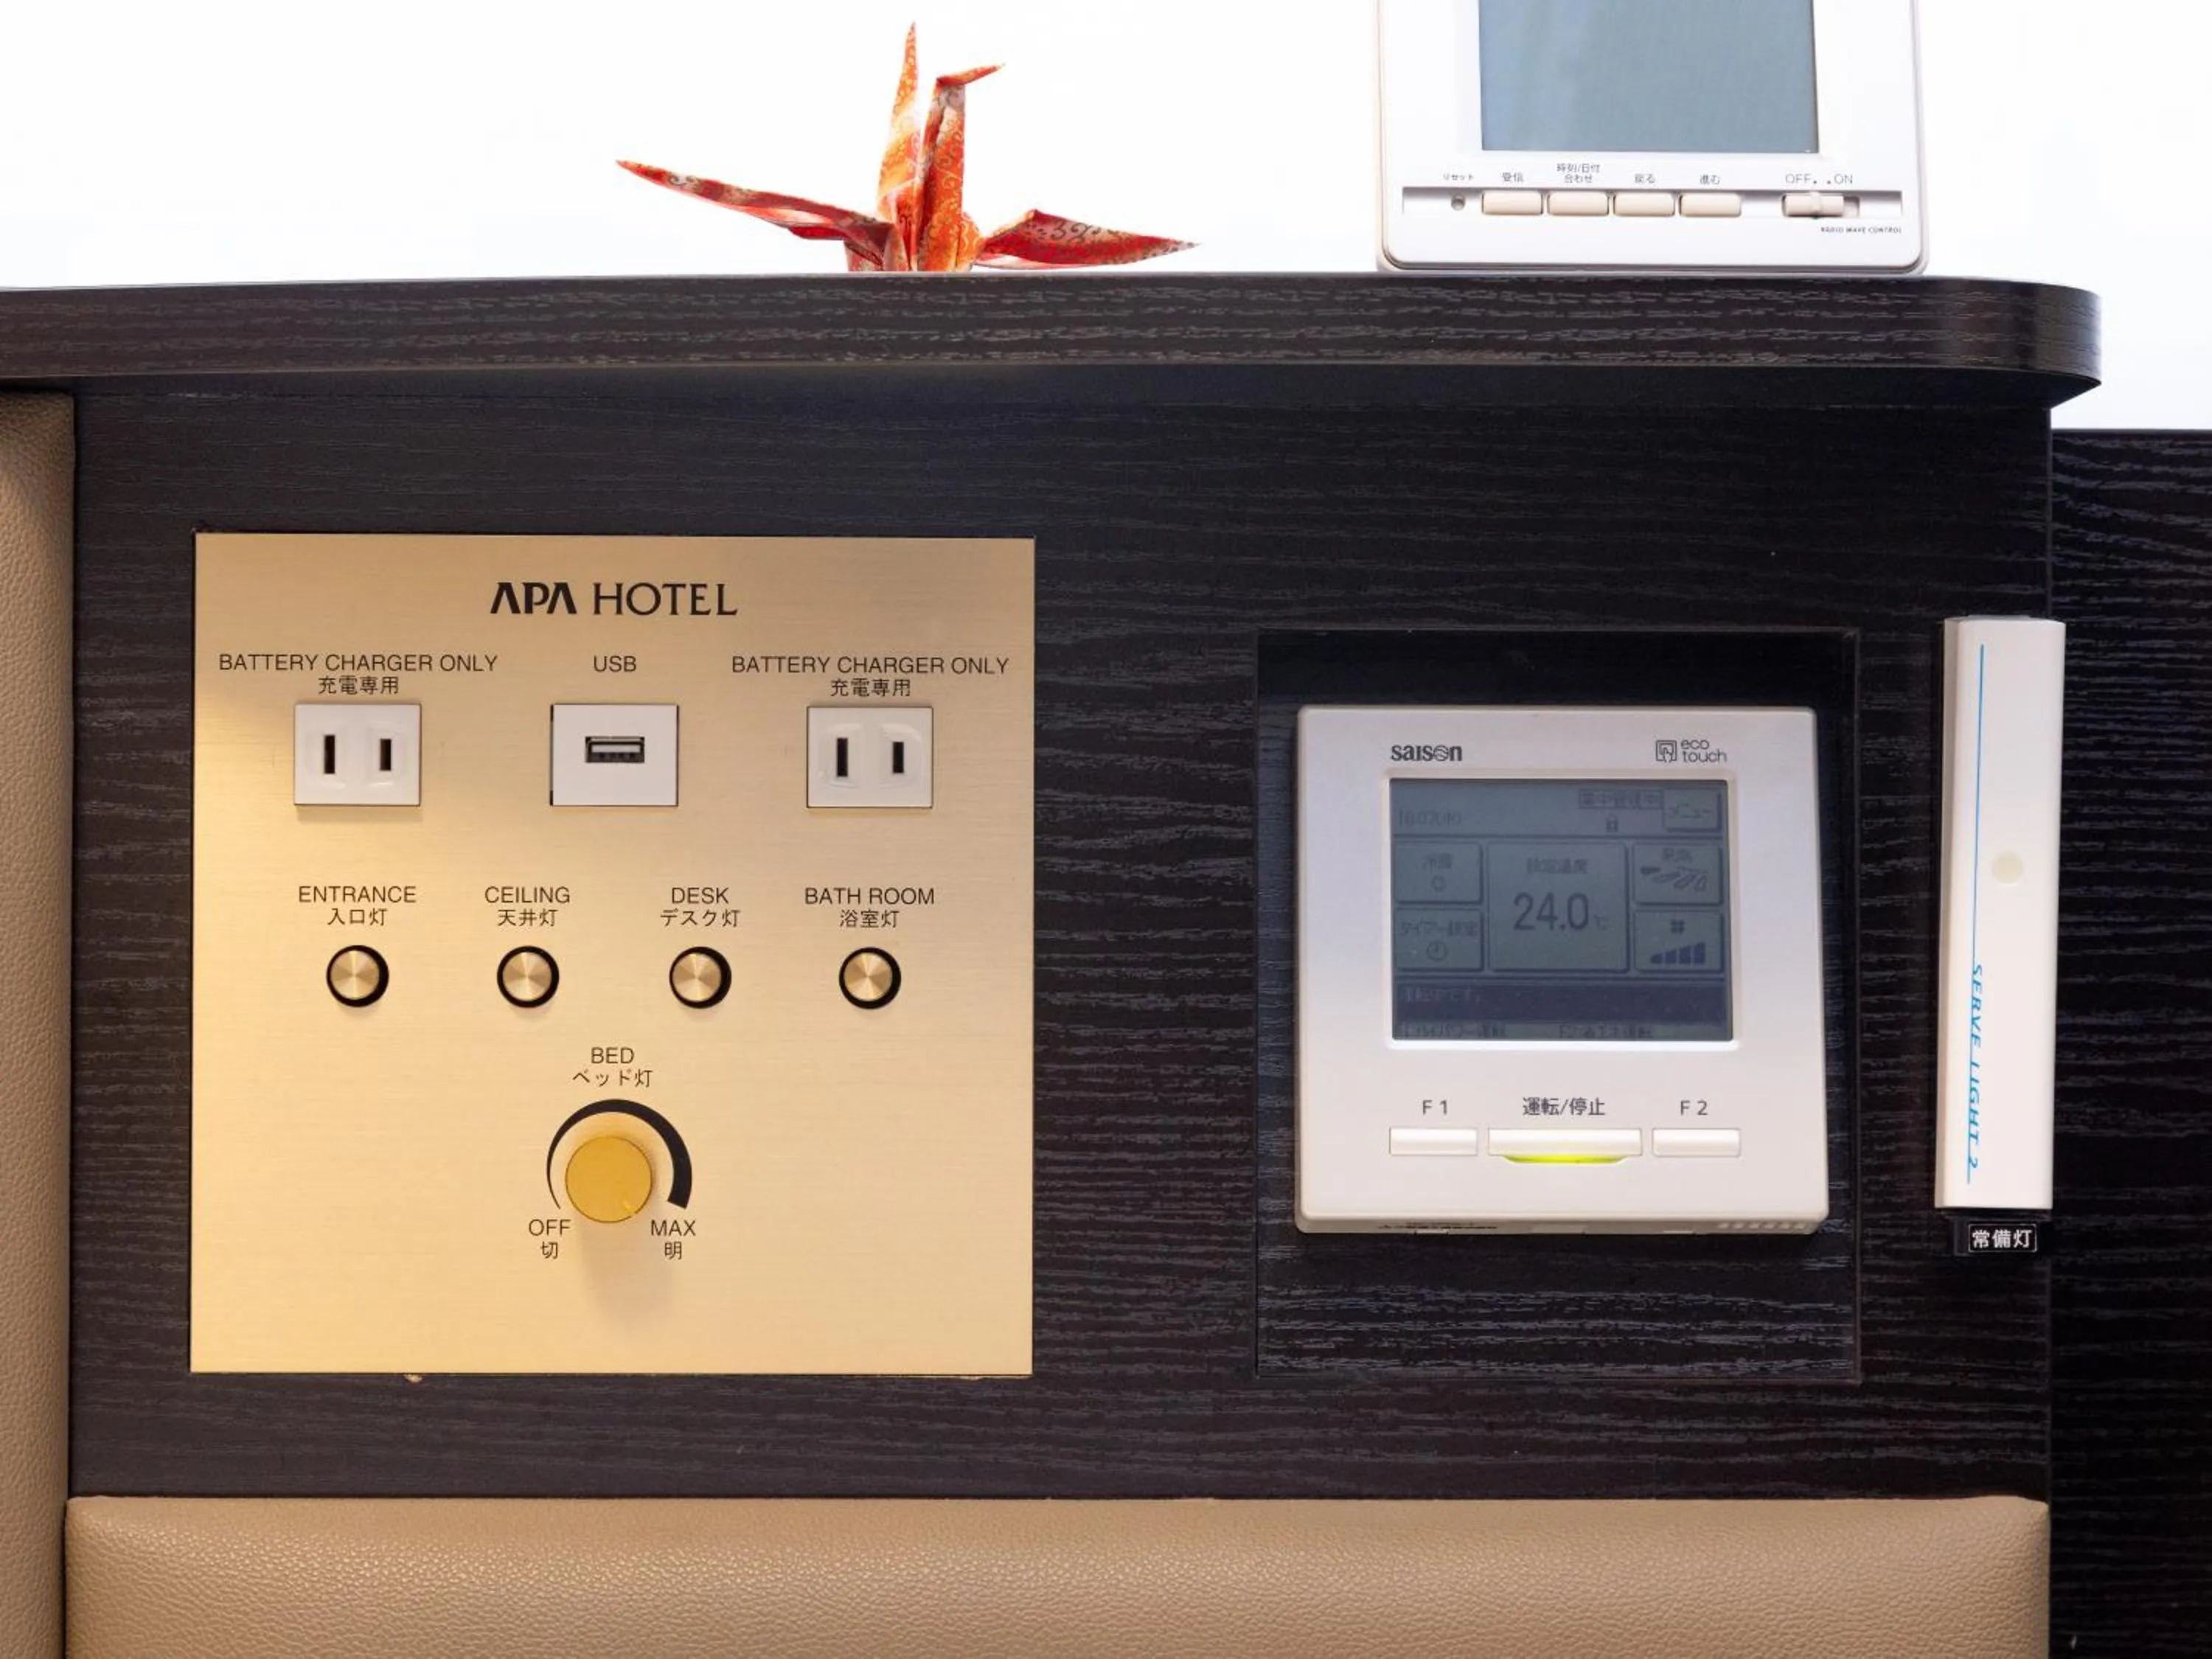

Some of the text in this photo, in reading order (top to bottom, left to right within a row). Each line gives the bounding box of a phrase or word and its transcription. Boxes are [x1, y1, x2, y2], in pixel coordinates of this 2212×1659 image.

[1501, 172, 1524, 183] 受信
[1634, 173, 1655, 184] 戻る
[1700, 174, 1720, 185] 進む
[490, 582, 737, 615] APA HOTEL
[220, 654, 497, 672] BATTERY CHARGER ONLY
[594, 655, 636, 672] USB
[733, 656, 1009, 674] BATTERY CHARGER ONLY
[319, 675, 398, 695] 充電専用
[831, 678, 910, 697] 充電専用
[1681, 740, 1709, 751] eco
[1681, 747, 1727, 762] touch
[299, 886, 416, 902] ENTRANCE
[485, 886, 570, 903] CEILING
[672, 887, 728, 904] DESK
[805, 888, 933, 905] BATH ROOM
[327, 908, 386, 926] 入口灯
[498, 908, 558, 926] 天井灯
[661, 908, 740, 927] デスク灯
[841, 908, 900, 928] 浴室灯
[1513, 892, 1589, 931] 24.0
[591, 1047, 634, 1064] BED
[1969, 964, 1983, 1169] SERVE LIGHT 2
[573, 1069, 653, 1088] ベッド灯
[1523, 1097, 1604, 1115] 運転/停止
[529, 1219, 571, 1236] OFF
[651, 1220, 695, 1236] MAX
[1972, 1229, 2033, 1249] 常備灯
[541, 1242, 558, 1259] 切
[664, 1242, 681, 1259] 明
